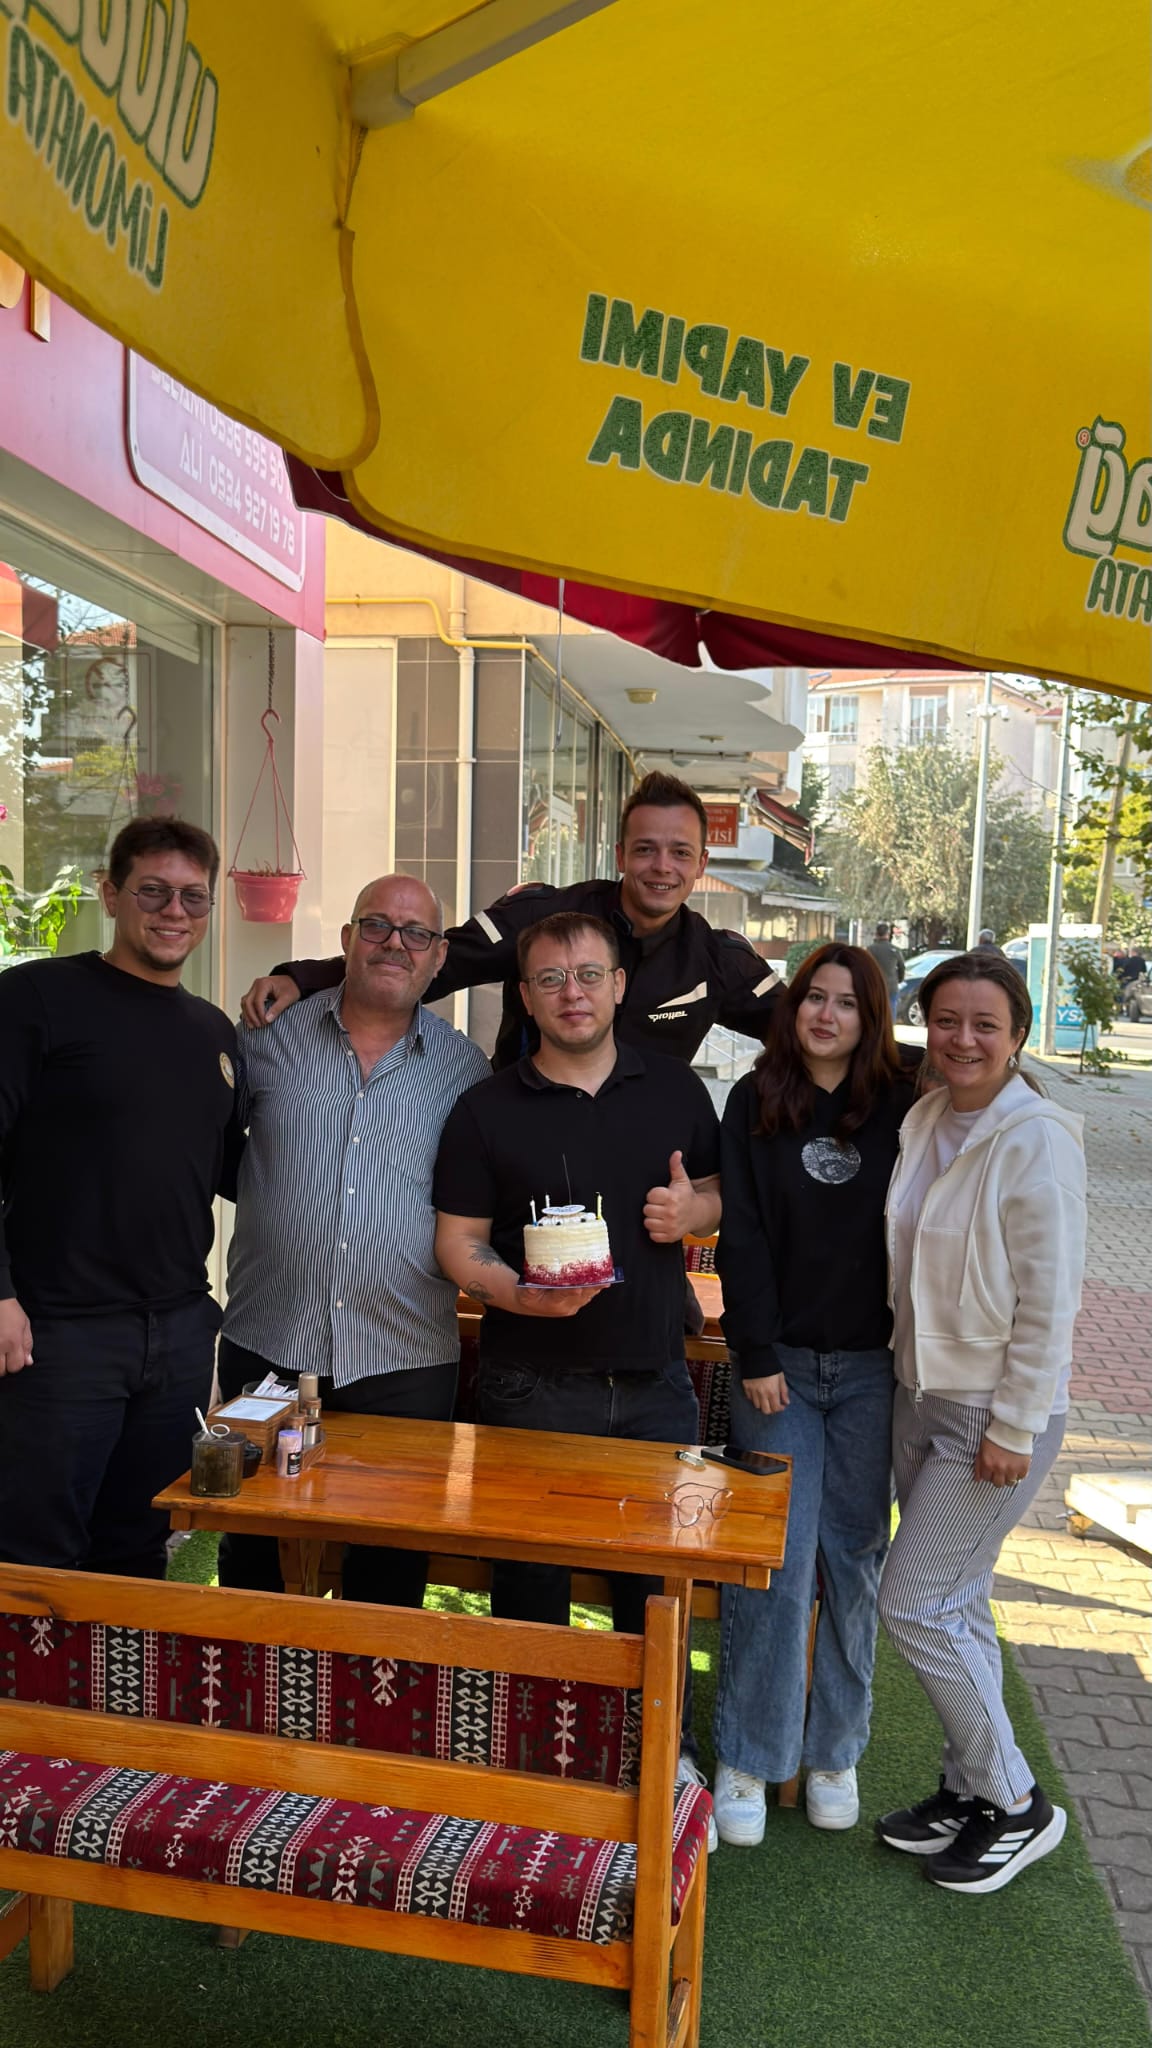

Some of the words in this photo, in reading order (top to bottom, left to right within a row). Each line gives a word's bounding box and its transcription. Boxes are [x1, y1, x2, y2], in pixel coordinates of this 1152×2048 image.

[245, 428, 268, 481] 595
[209, 455, 242, 517] 0534
[244, 484, 267, 533] 927
[269, 503, 281, 545] 19
[282, 515, 296, 556] 78
